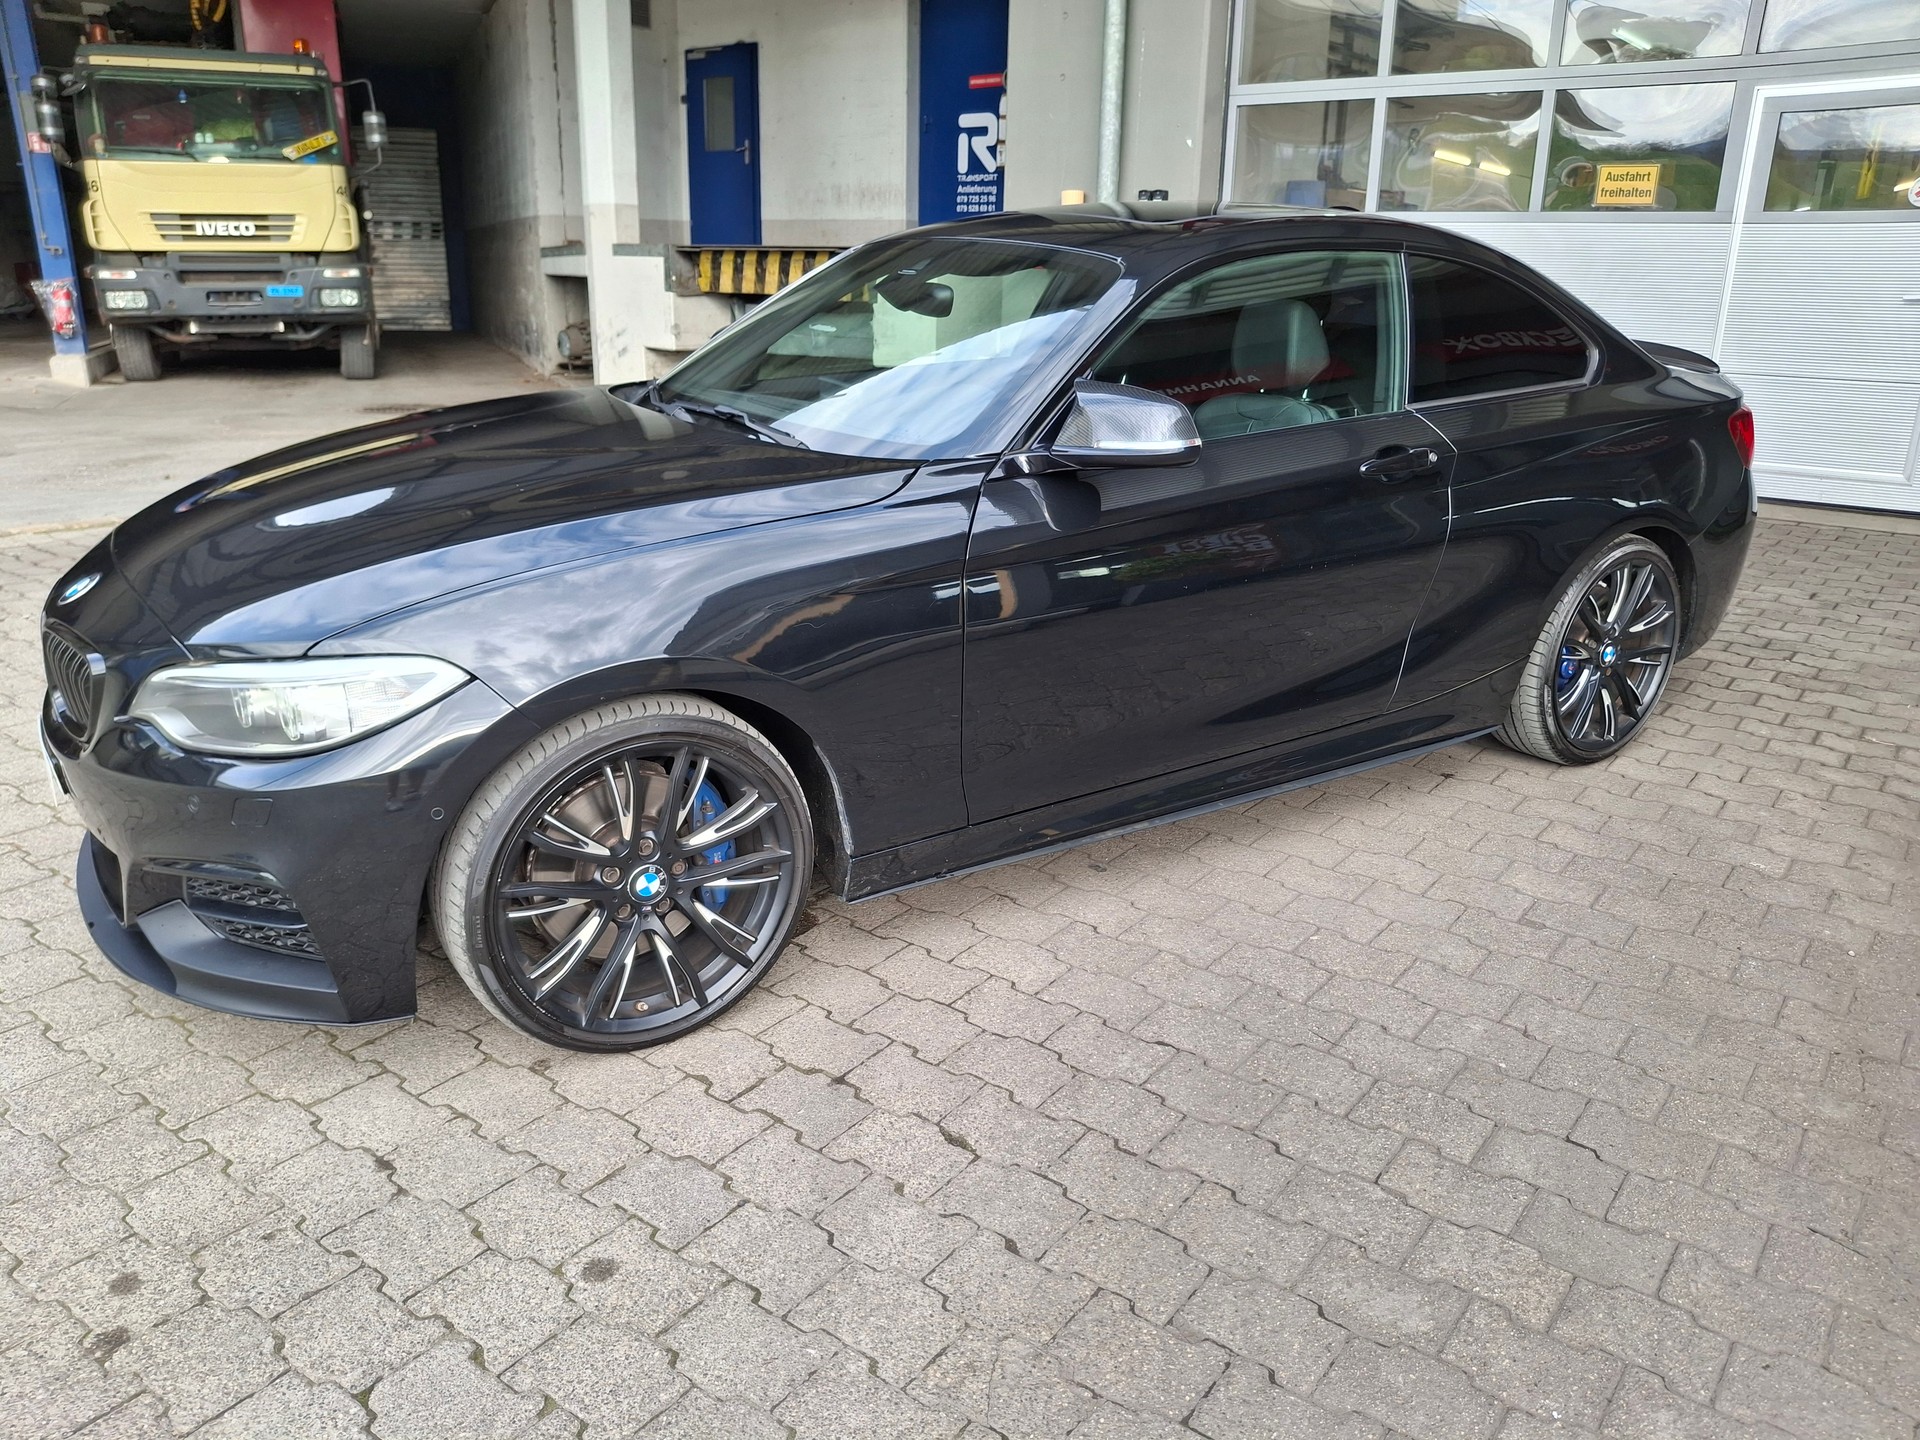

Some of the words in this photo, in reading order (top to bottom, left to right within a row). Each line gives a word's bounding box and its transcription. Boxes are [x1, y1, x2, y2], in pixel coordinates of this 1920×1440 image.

[957, 174, 998, 182] TRANSPORT
[1605, 171, 1651, 182] Ausfahrt
[957, 184, 997, 195] Anlieferung
[1600, 187, 1652, 198] freihalten
[956, 195, 968, 203] 079
[956, 204, 968, 212] 079
[195, 221, 256, 236] IVECO
